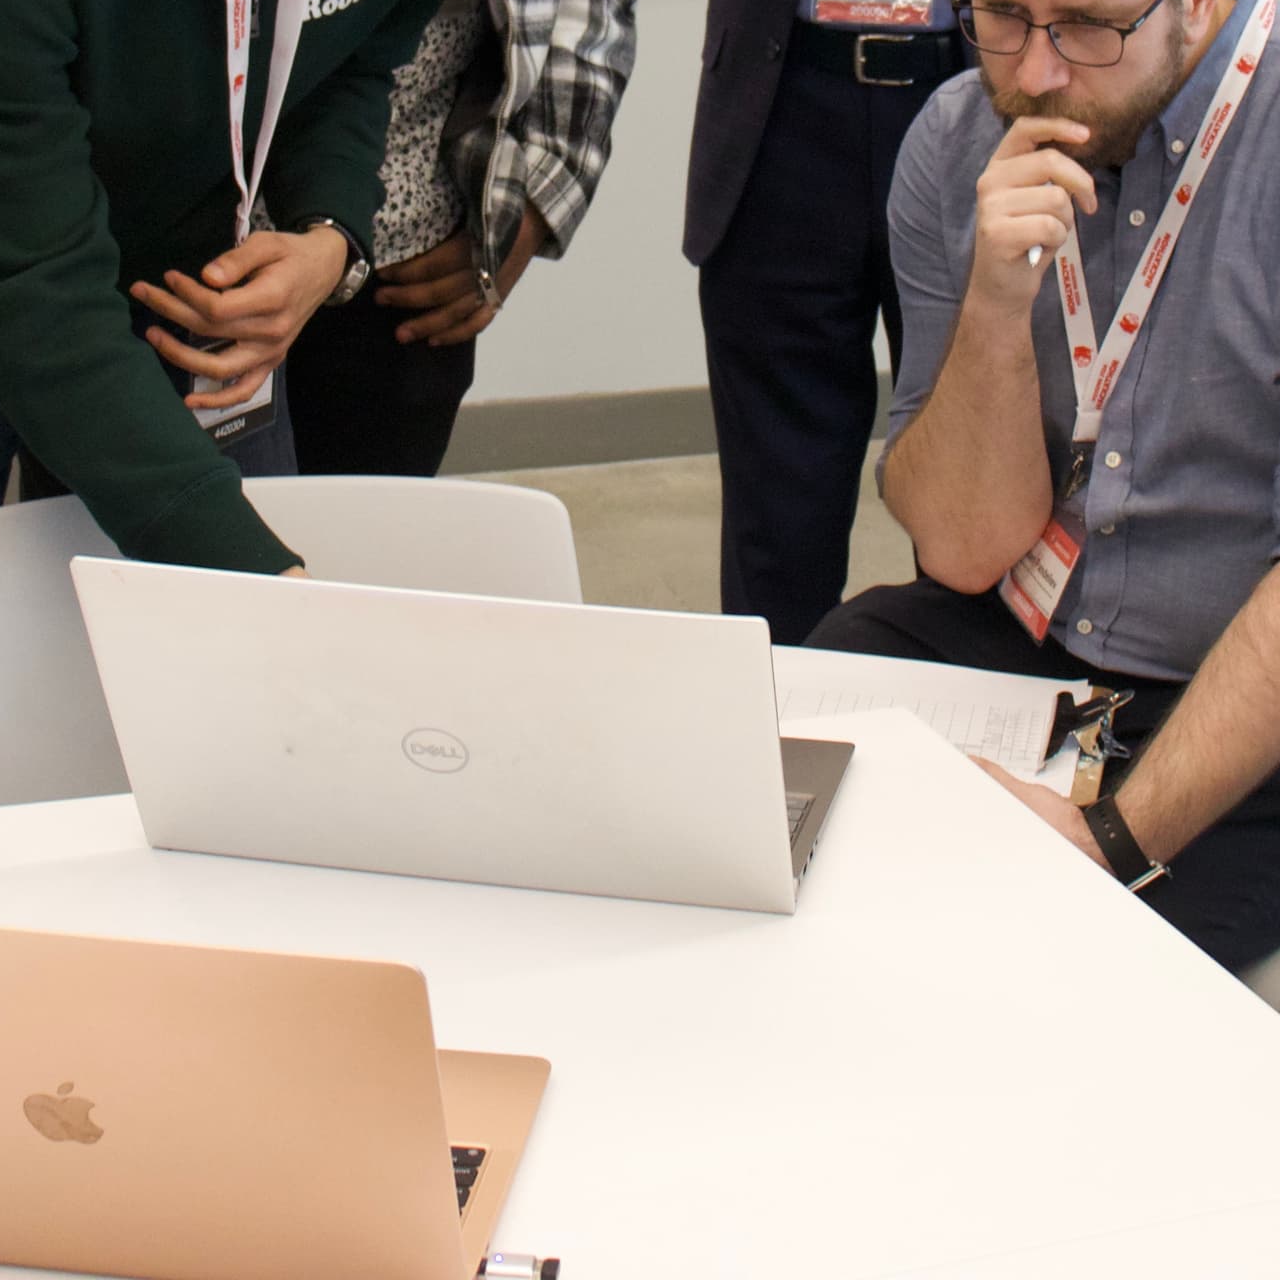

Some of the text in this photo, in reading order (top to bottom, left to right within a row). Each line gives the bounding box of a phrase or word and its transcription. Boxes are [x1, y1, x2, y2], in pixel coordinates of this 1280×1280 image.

[1200, 102, 1232, 159] HACKATHON
[1060, 256, 1077, 316] HACKATHON
[1144, 232, 1171, 288] HACKATHON
[1095, 359, 1120, 410] HACKATHON
[410, 742, 465, 760] DELL
